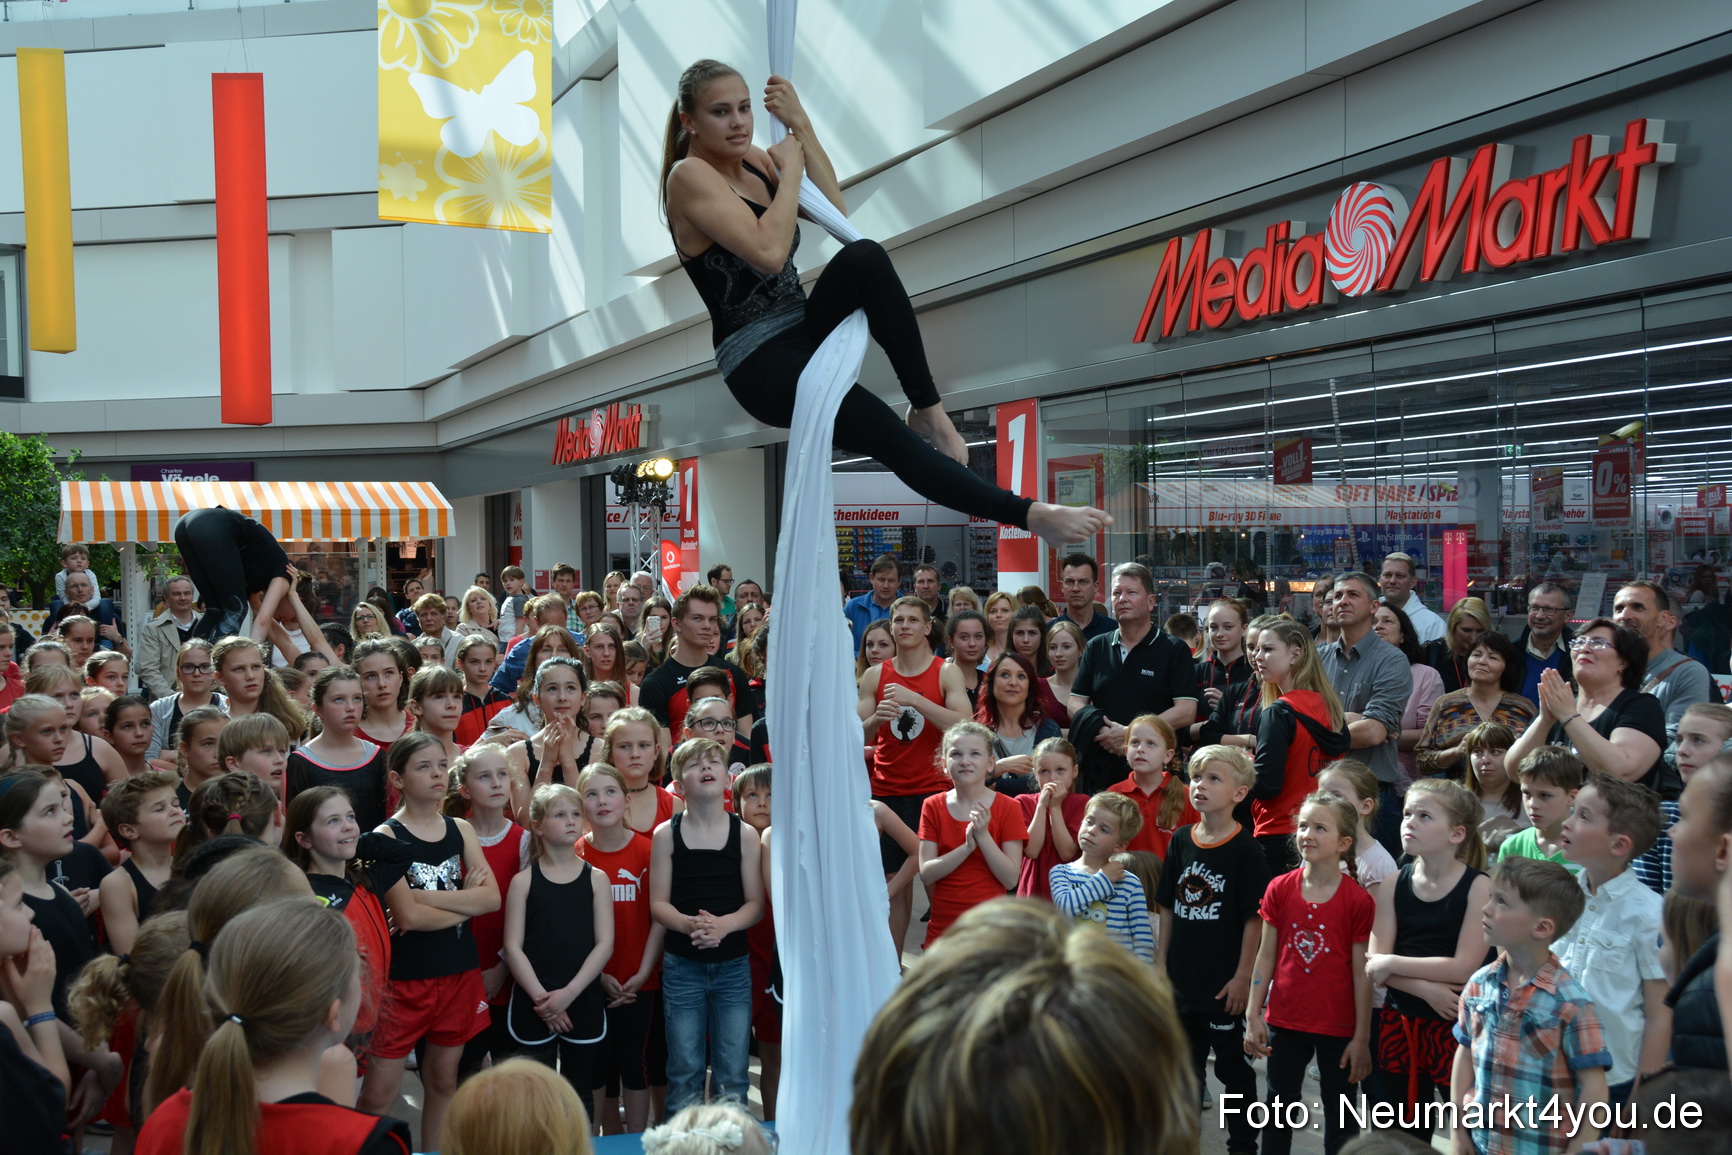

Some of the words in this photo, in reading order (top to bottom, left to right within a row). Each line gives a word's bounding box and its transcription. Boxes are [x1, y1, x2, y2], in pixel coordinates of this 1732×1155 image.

[1132, 220, 1323, 343] Media
[1375, 118, 1662, 292] Markt
[552, 417, 591, 465] Media
[600, 402, 643, 456] Markt
[684, 467, 694, 522] 1
